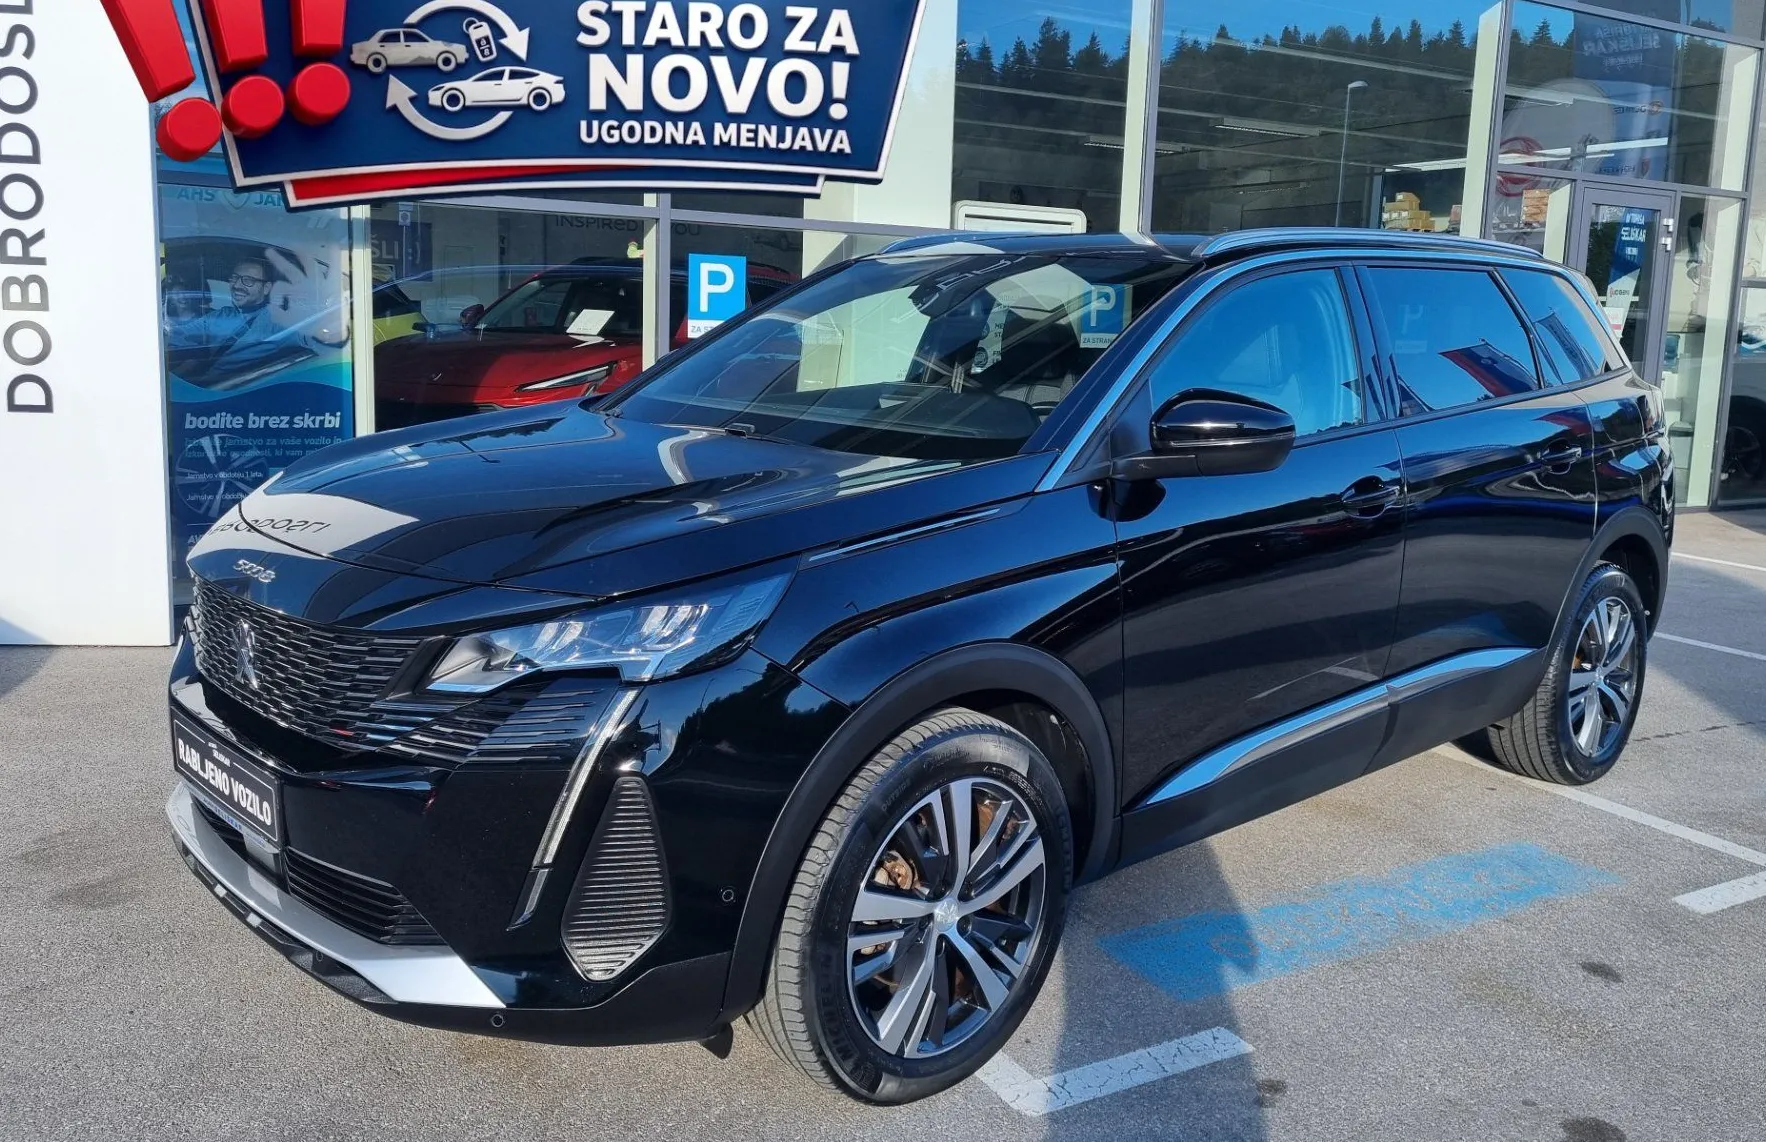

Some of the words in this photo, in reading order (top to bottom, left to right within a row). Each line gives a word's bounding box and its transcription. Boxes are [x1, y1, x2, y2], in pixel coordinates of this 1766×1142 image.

[700, 262, 735, 313] P
[1090, 285, 1117, 327] P
[185, 412, 244, 429] bodite
[248, 412, 290, 429] brez
[293, 411, 341, 429] skrbi
[233, 559, 276, 583] 5008
[177, 737, 230, 796] RABLJENO
[230, 777, 272, 826] VOZILO
